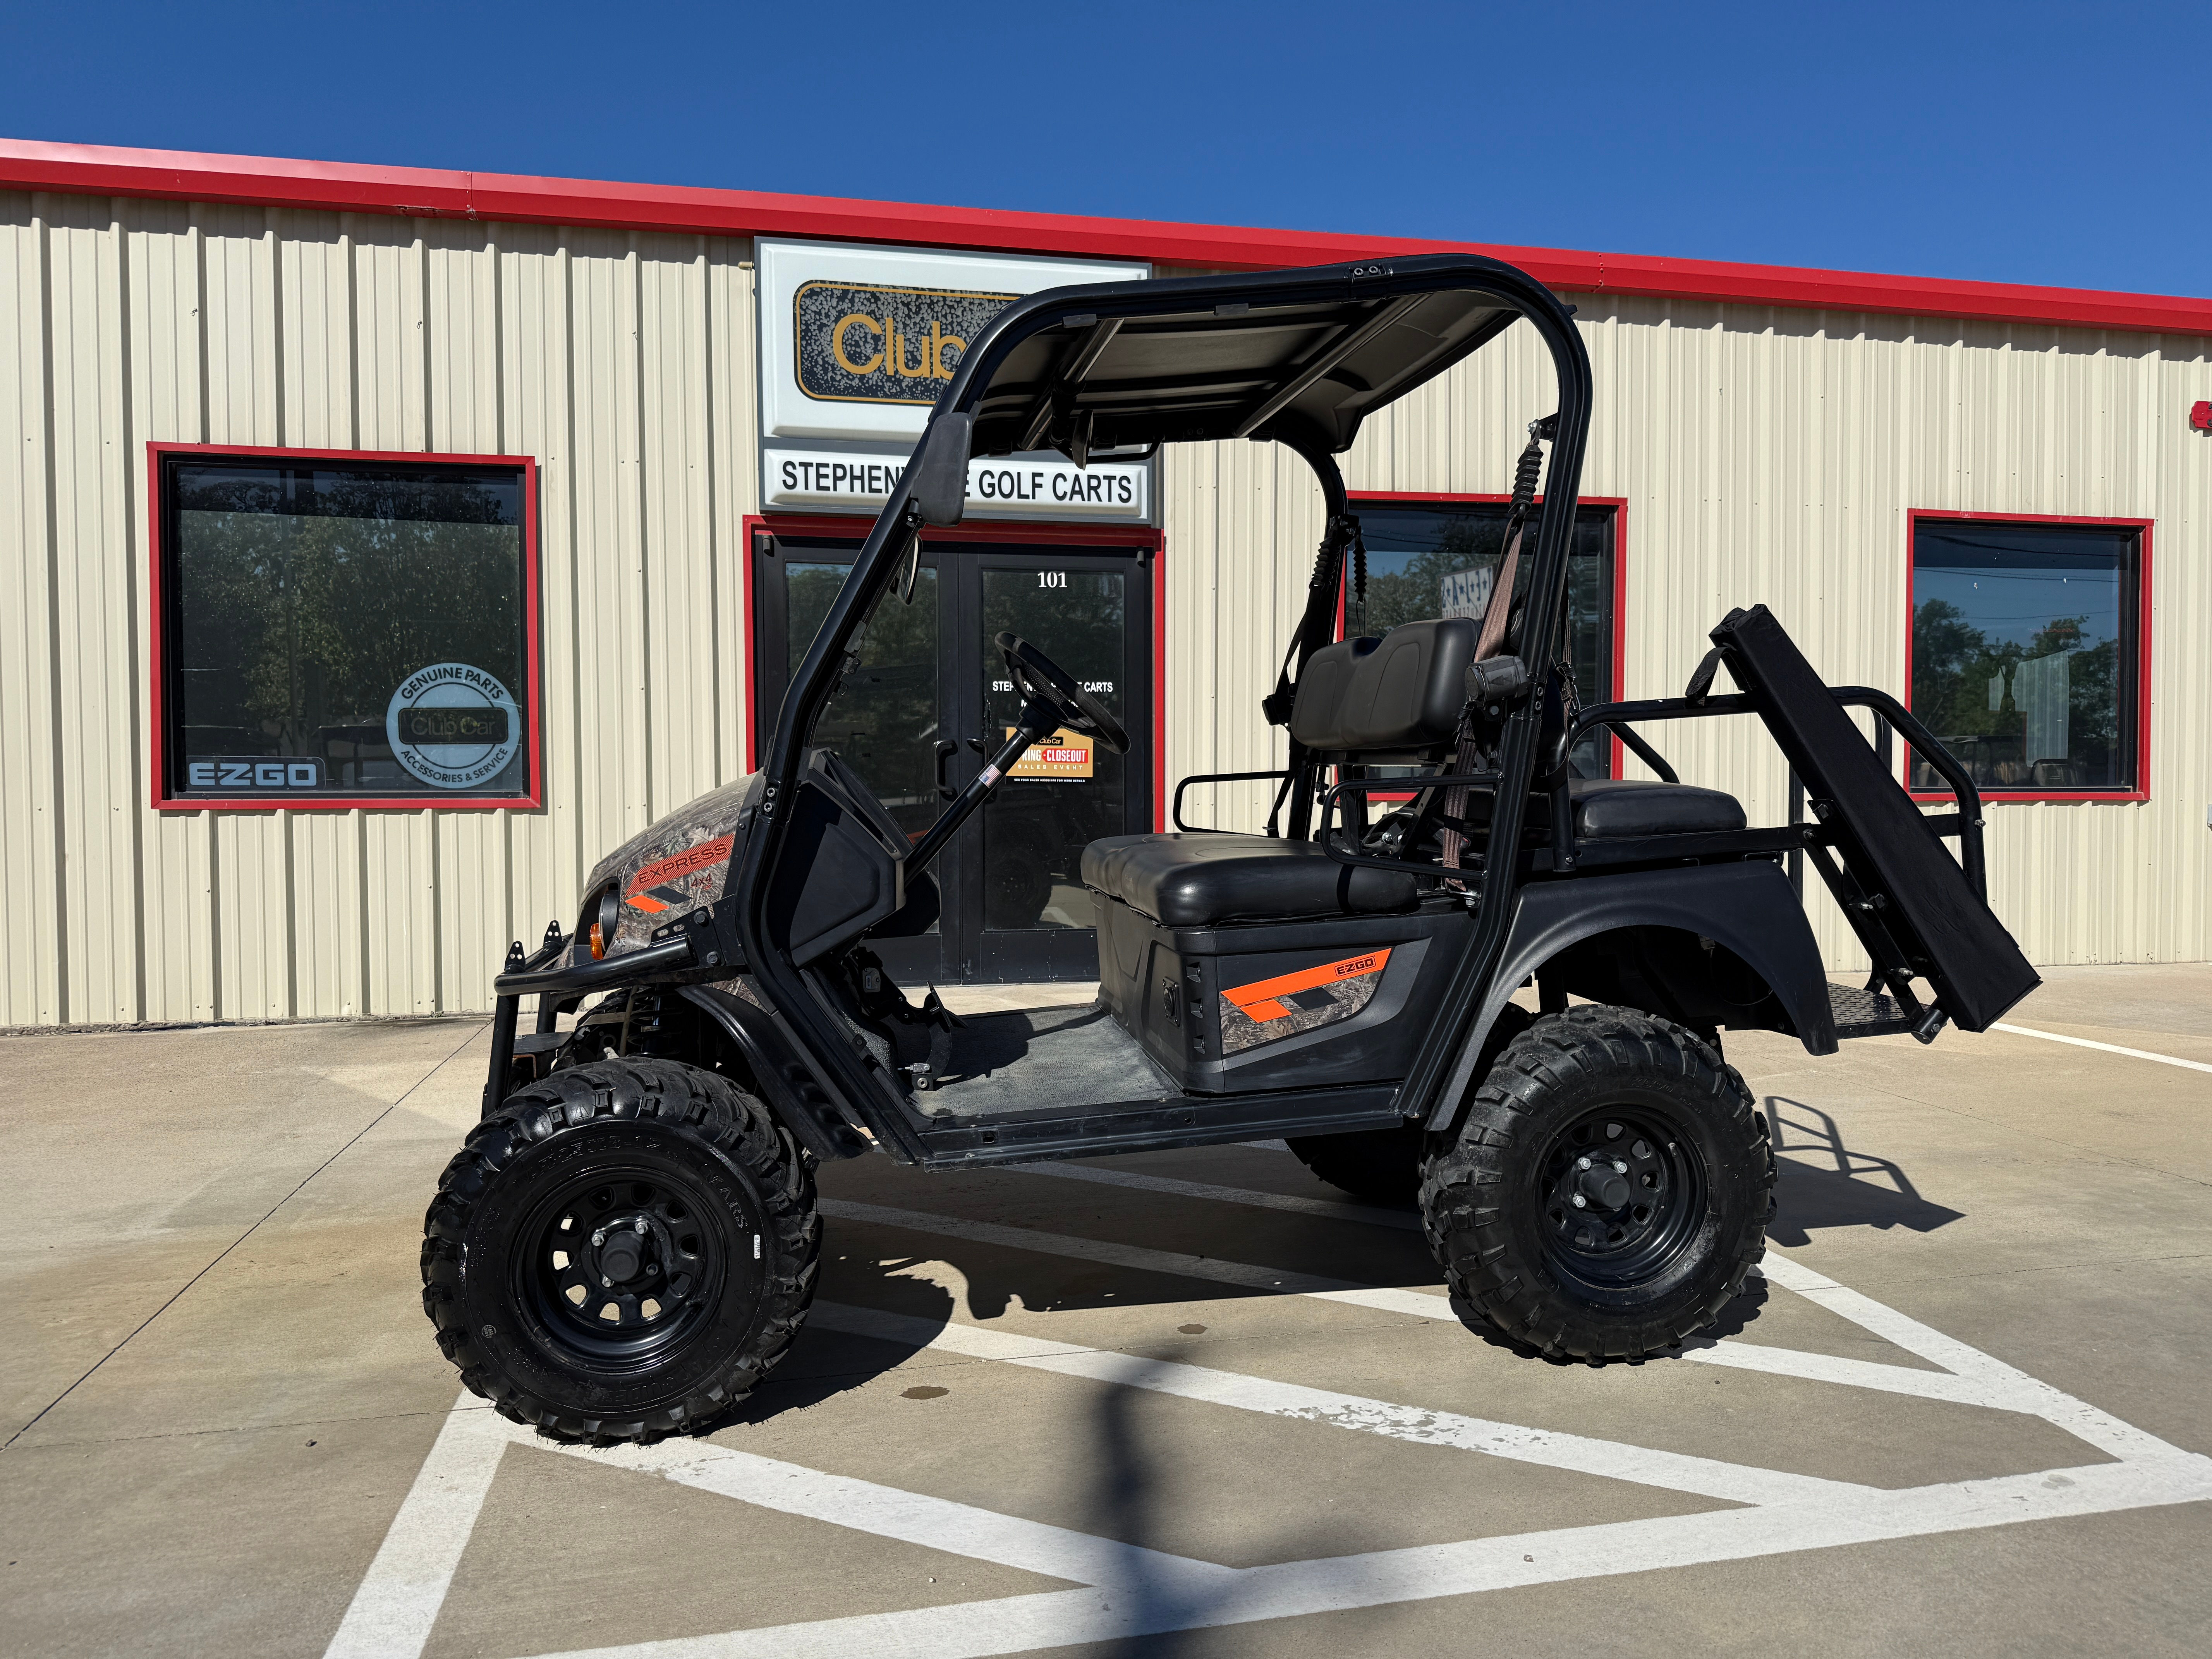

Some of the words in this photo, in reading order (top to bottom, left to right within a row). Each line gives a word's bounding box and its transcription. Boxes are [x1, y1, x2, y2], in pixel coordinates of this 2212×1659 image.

[833, 313, 966, 380] Club
[782, 461, 970, 497] STEPHEN
[979, 470, 1044, 499] GOLF
[1052, 472, 1132, 503] CARTS
[1037, 571, 1067, 588] 101
[401, 667, 462, 699] GENUINE
[465, 670, 503, 699] PARTS
[1084, 682, 1113, 692] CARTS
[411, 717, 457, 735] Club
[460, 716, 495, 735] Car
[401, 750, 463, 782] ACCESSORIES
[473, 748, 508, 778] SERVICE
[1022, 749, 1041, 761] RING
[1047, 750, 1086, 762] CLOSEOUT
[189, 763, 317, 786] EZGO
[639, 844, 726, 883] EXPRESS
[691, 872, 712, 888] 4x4
[1337, 958, 1374, 974] EZGO
